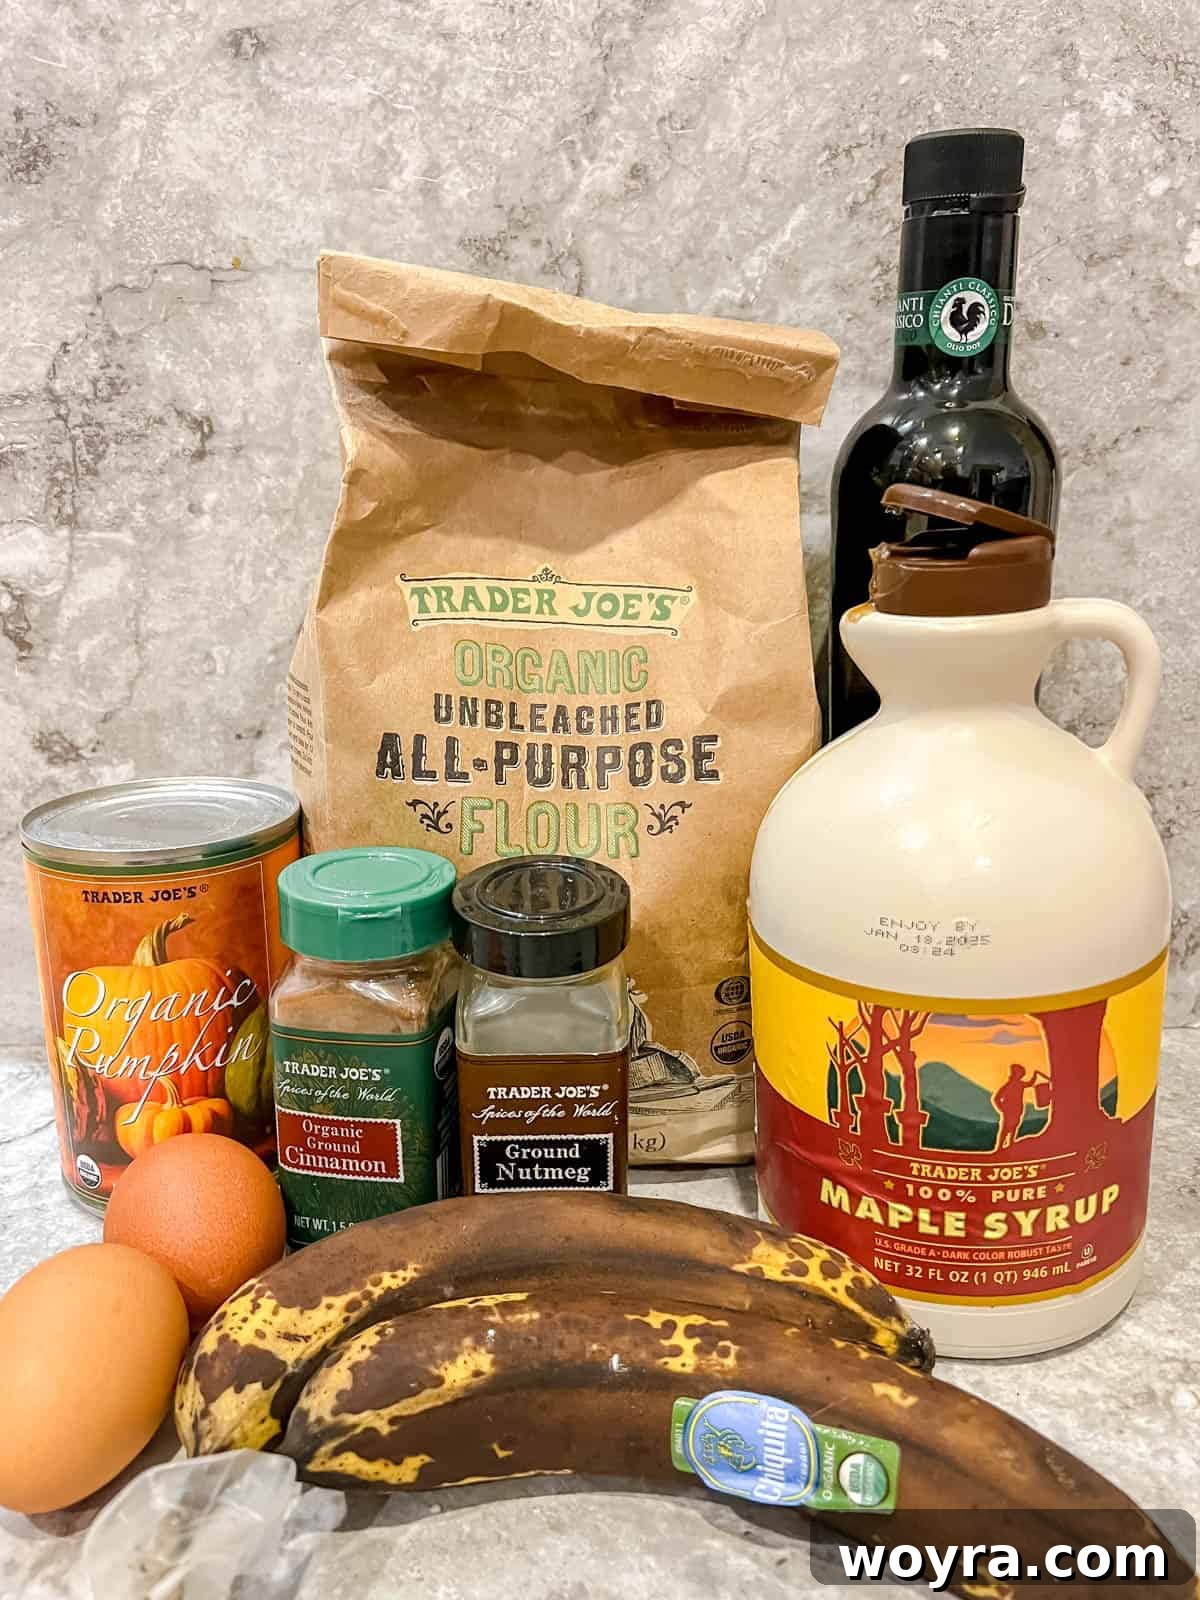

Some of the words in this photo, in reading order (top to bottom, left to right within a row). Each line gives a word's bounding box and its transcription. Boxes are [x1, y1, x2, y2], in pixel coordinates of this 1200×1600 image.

[933, 283, 964, 327] CHIANTI
[968, 281, 997, 326] CLASSICO
[946, 341, 965, 352] OLIO
[409, 585, 559, 617] TRADER
[568, 590, 680, 622] JOE'S
[453, 638, 650, 696] ORGANIC
[433, 692, 666, 736] UNBLEACHED
[374, 731, 722, 792] ALL-PURPOSE
[459, 795, 641, 860] FLOUR
[82, 889, 145, 904] TRADER
[149, 885, 197, 902] JOE'S
[863, 926, 899, 941] JAN
[879, 916, 941, 932] ENJOY
[954, 920, 978, 933] BY
[62, 967, 258, 1040] Organic
[65, 1014, 263, 1112] Pumpkin
[283, 1060, 337, 1078] TRADER
[340, 1067, 384, 1081] JOE'S
[278, 1078, 313, 1097] Spices
[314, 1085, 334, 1103] of
[328, 1085, 351, 1100] the
[357, 1086, 401, 1102] World
[487, 1086, 552, 1099] TRADER
[555, 1085, 601, 1098] JOE'S
[472, 1104, 523, 1125] Spices
[524, 1104, 549, 1124] of
[541, 1104, 567, 1118] the
[573, 1100, 619, 1118] World
[302, 1119, 365, 1140] Organic
[306, 1136, 361, 1154] Ground
[505, 1143, 581, 1160] Ground
[633, 1131, 666, 1153] kg)
[285, 1145, 387, 1174] Cinnamon
[909, 1162, 983, 1181] TRADER
[987, 1164, 1040, 1181] JOE'S
[495, 1162, 592, 1183] Nutmeg
[905, 1183, 977, 1203] 100%
[991, 1185, 1048, 1203] PURE
[819, 1177, 969, 1239] MAPLE
[983, 1182, 1120, 1240] SYRUP
[294, 1215, 311, 1229] NET
[312, 1217, 331, 1232] WT.
[874, 1237, 892, 1249] U.S.
[893, 1242, 927, 1257] GRADE
[972, 1251, 1005, 1261] COLOR
[1007, 1246, 1043, 1260] ROBUST
[874, 1256, 901, 1273] NET
[905, 1264, 923, 1279] 32
[928, 1268, 944, 1281] FL
[949, 1270, 969, 1283] OZ
[974, 1270, 987, 1285] (1
[993, 1270, 1018, 1284] QT)
[1023, 1266, 1049, 1280] 946
[1052, 1262, 1072, 1276] mL
[753, 1406, 793, 1501] Chiquita
